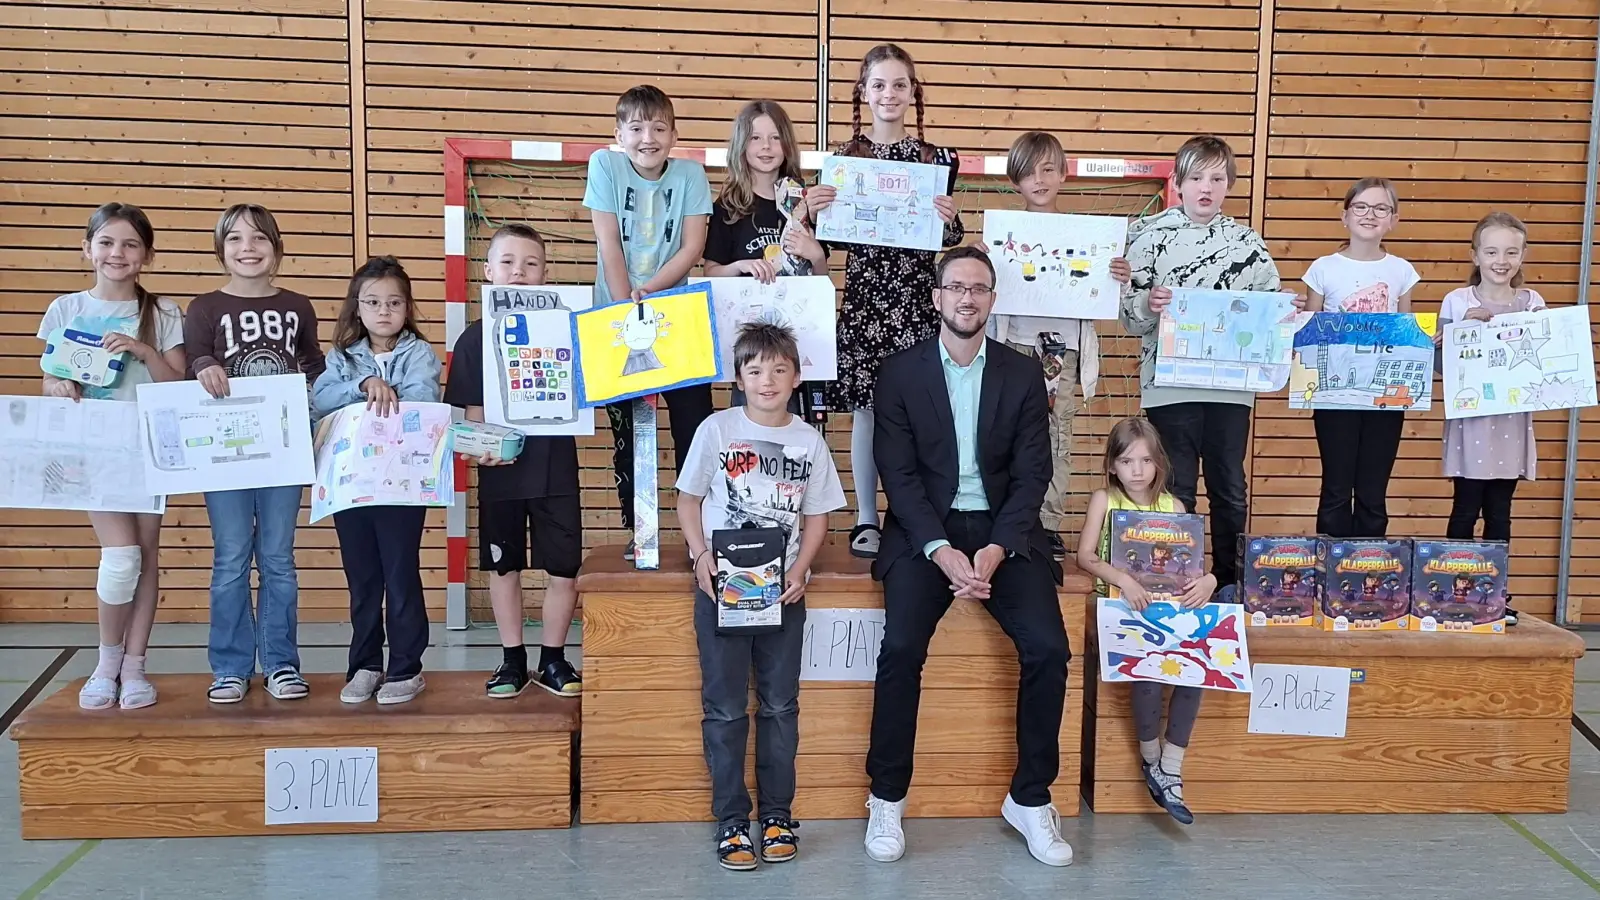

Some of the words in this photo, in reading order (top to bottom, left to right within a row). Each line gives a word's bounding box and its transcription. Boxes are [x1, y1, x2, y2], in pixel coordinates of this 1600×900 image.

[758, 227, 780, 235] AUCH
[492, 290, 559, 312] HANDY
[220, 310, 299, 359] 1982
[719, 450, 756, 474] SURF
[759, 453, 778, 476] NO
[1127, 528, 1190, 541] KLAPPERFALLE
[1342, 558, 1400, 570] KLAPPERFALLE
[1428, 559, 1494, 573] KLAPPERFALLE
[804, 624, 818, 668] 1.
[829, 620, 885, 668] PLAT
[268, 761, 299, 812] 3.
[310, 756, 376, 809] PLATZ
